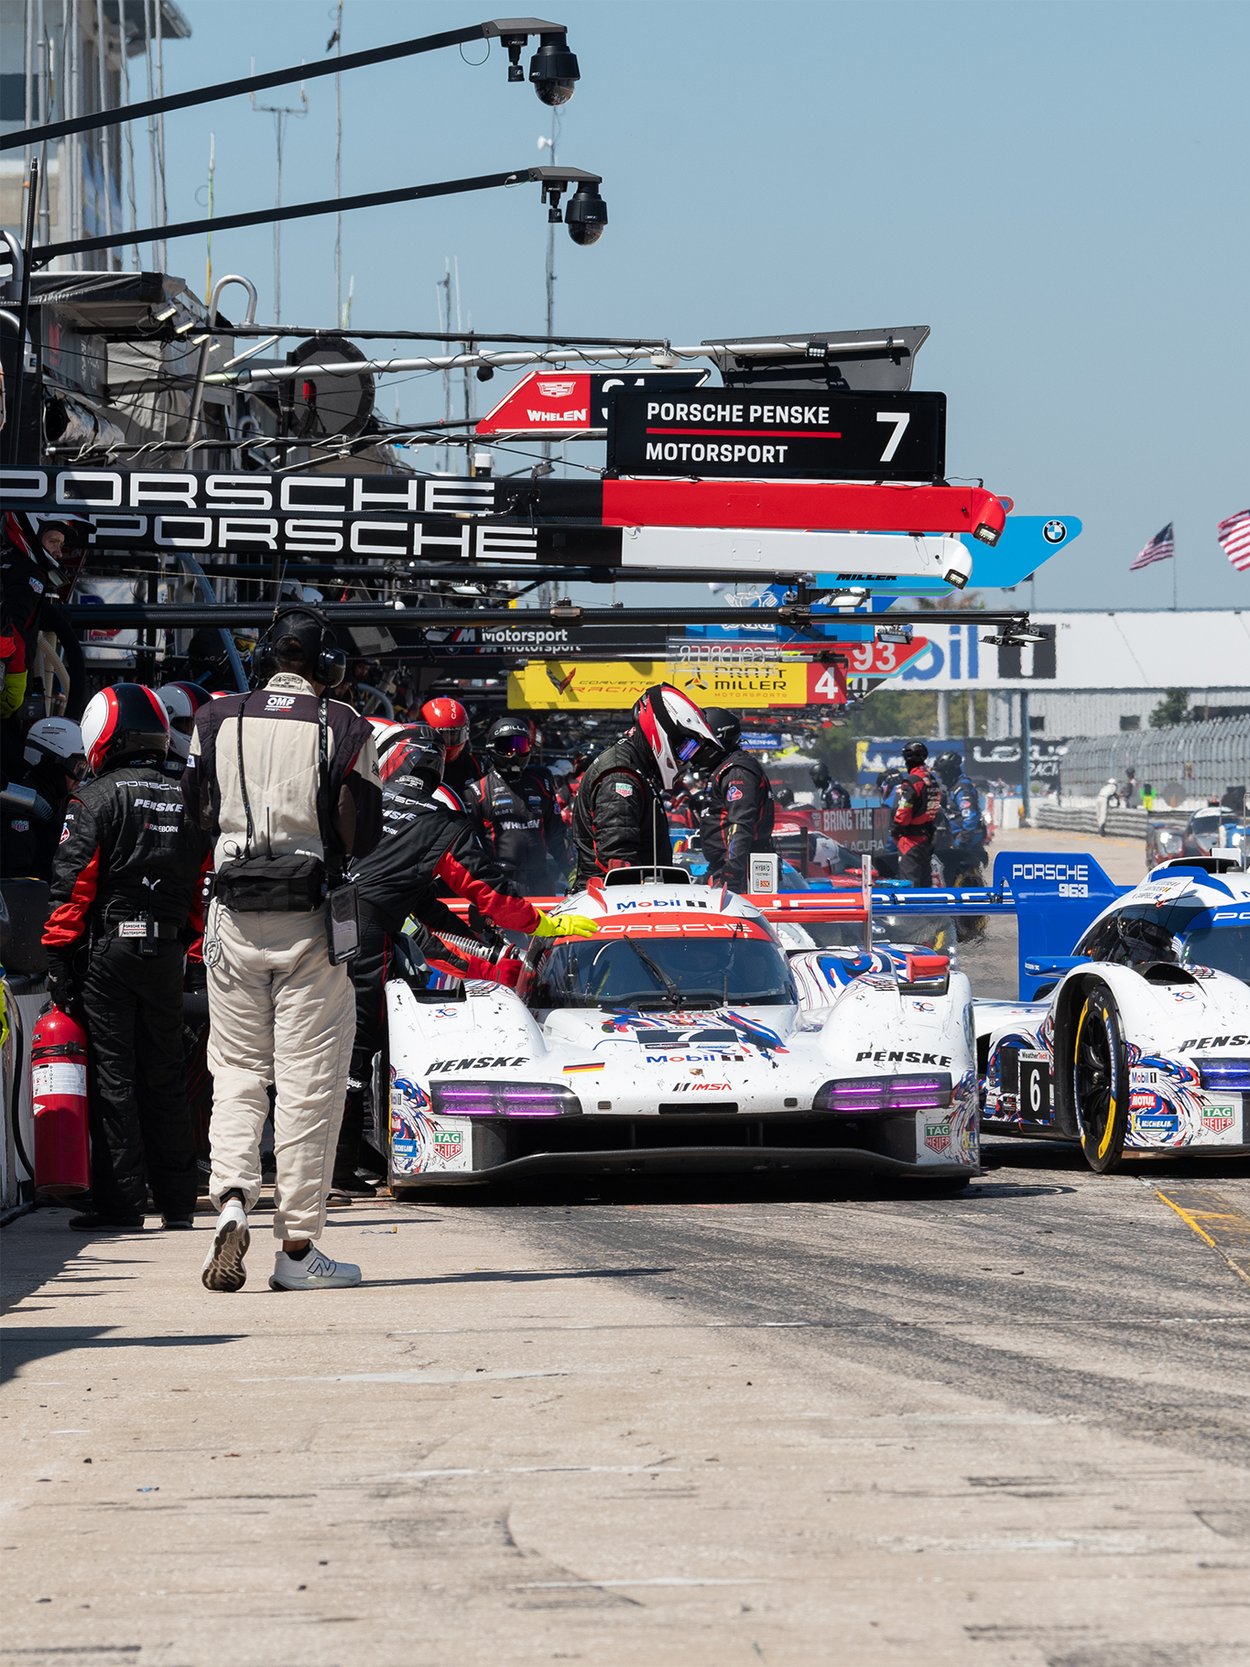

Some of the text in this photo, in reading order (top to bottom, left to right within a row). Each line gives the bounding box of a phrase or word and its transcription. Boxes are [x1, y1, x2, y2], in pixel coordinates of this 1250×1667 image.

[527, 408, 588, 422] WHELEN
[647, 402, 830, 424] PORSCHE PENSKE
[876, 412, 910, 462] 7
[646, 442, 788, 463] MOTORSPORT
[0, 470, 495, 514] PORSCHE
[88, 513, 538, 560] PORSCHE
[482, 628, 568, 645] Motorsport
[852, 641, 897, 672] 93
[714, 680, 787, 690] MILLER
[814, 666, 839, 700] 4
[267, 697, 295, 707] OMP
[115, 780, 183, 792] PORSCH
[823, 808, 852, 832] BRING
[855, 808, 873, 831] THE
[850, 839, 885, 852] ACURA
[1012, 863, 1089, 880] PORSCHE
[1058, 883, 1089, 898] 963
[616, 899, 681, 910] Mobil
[597, 923, 753, 933] ORSCHE
[667, 1028, 705, 1042] 7
[646, 1054, 716, 1063] Mobil
[855, 1050, 952, 1068] PENSKE
[424, 1056, 530, 1077] PENSKE
[1131, 1071, 1149, 1083] Mobil
[691, 1083, 733, 1091] IMSA
[1029, 1068, 1041, 1112] 6
[1131, 1095, 1156, 1107] MOTUL
[1204, 1107, 1232, 1117] TAG
[927, 1126, 949, 1136] TAG
[1203, 1117, 1233, 1133] HEUER
[435, 1133, 460, 1143] TAG
[434, 1144, 461, 1160] HEUER
